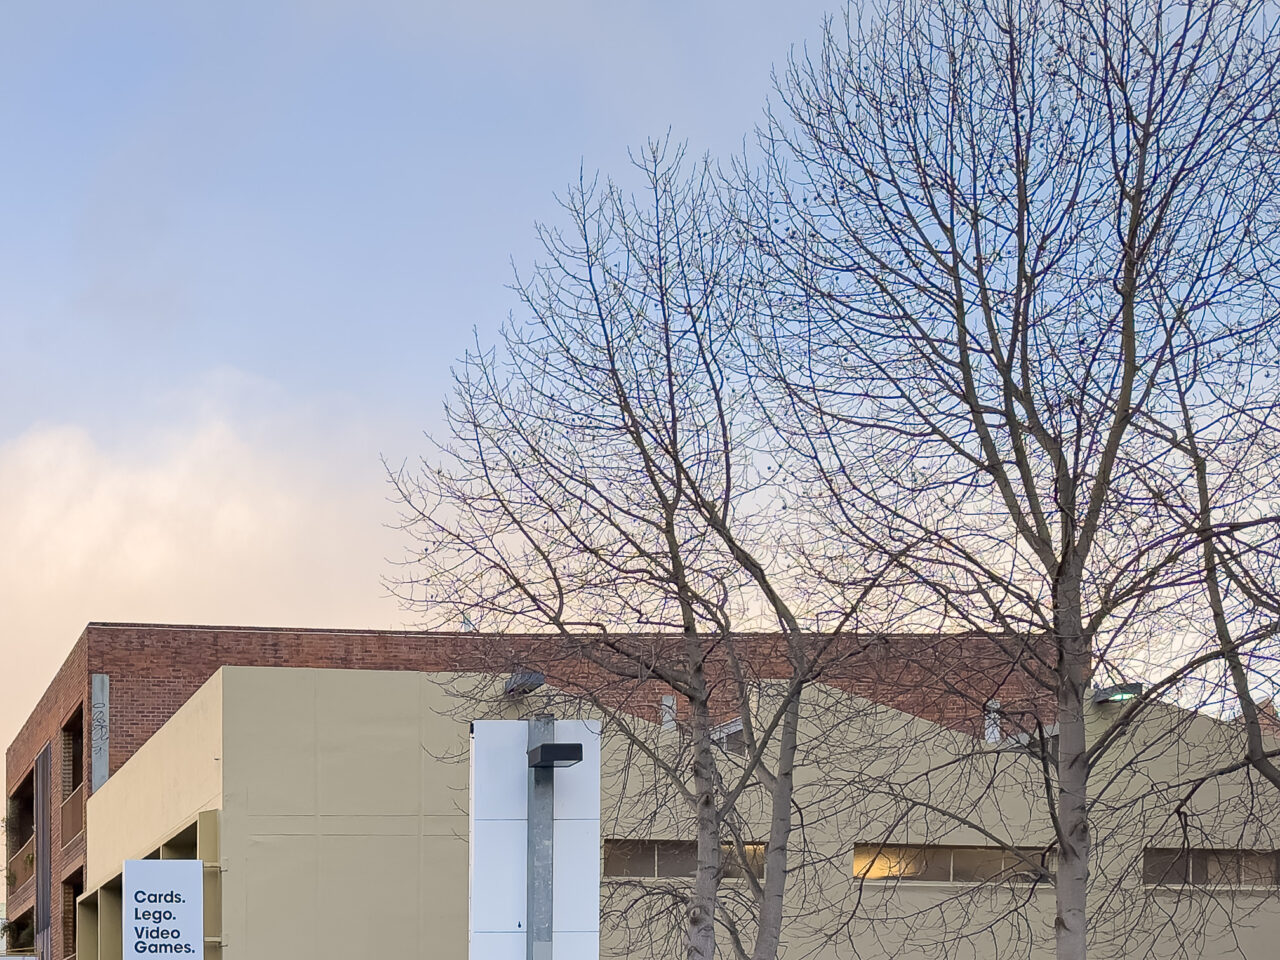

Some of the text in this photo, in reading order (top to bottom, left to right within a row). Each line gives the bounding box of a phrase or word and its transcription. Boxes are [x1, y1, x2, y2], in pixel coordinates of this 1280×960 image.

[134, 890, 186, 903] Cards.
[134, 907, 176, 924] Lego.
[134, 926, 181, 939] Video
[134, 940, 195, 954] Games.
